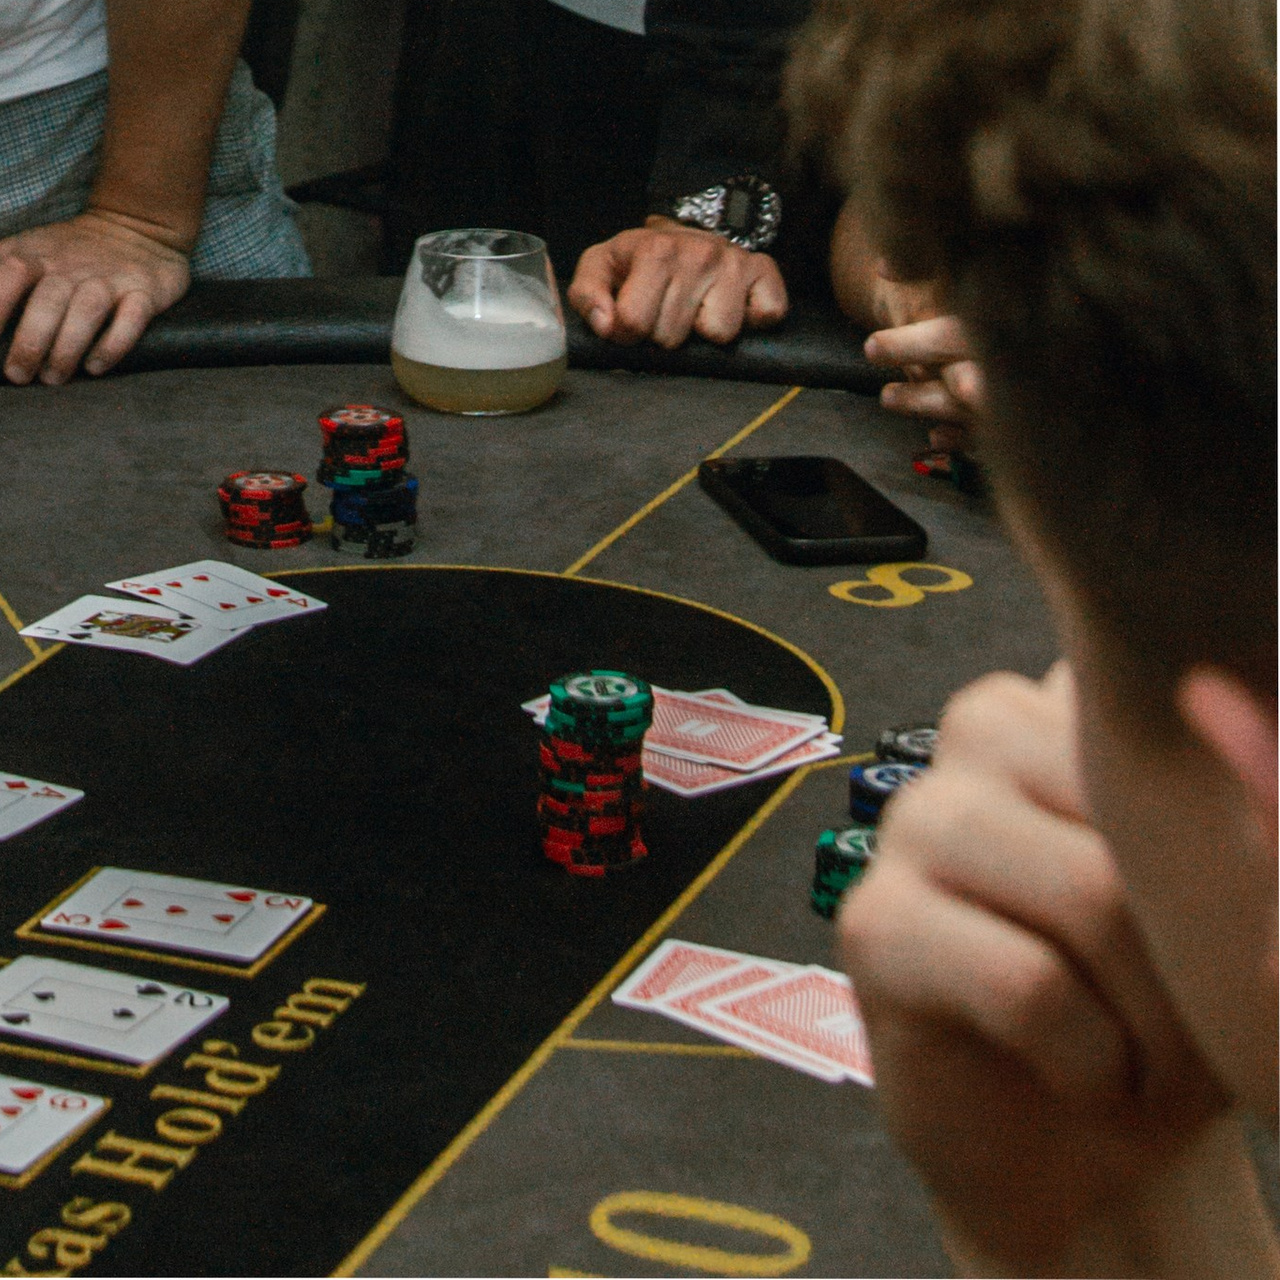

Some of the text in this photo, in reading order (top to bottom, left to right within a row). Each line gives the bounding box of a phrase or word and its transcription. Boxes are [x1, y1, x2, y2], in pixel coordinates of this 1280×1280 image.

[827, 562, 975, 609] 8
[283, 596, 309, 609] 4
[32, 785, 67, 800] A
[263, 894, 303, 910] 3
[52, 911, 92, 926] 3
[173, 990, 215, 1009] 2
